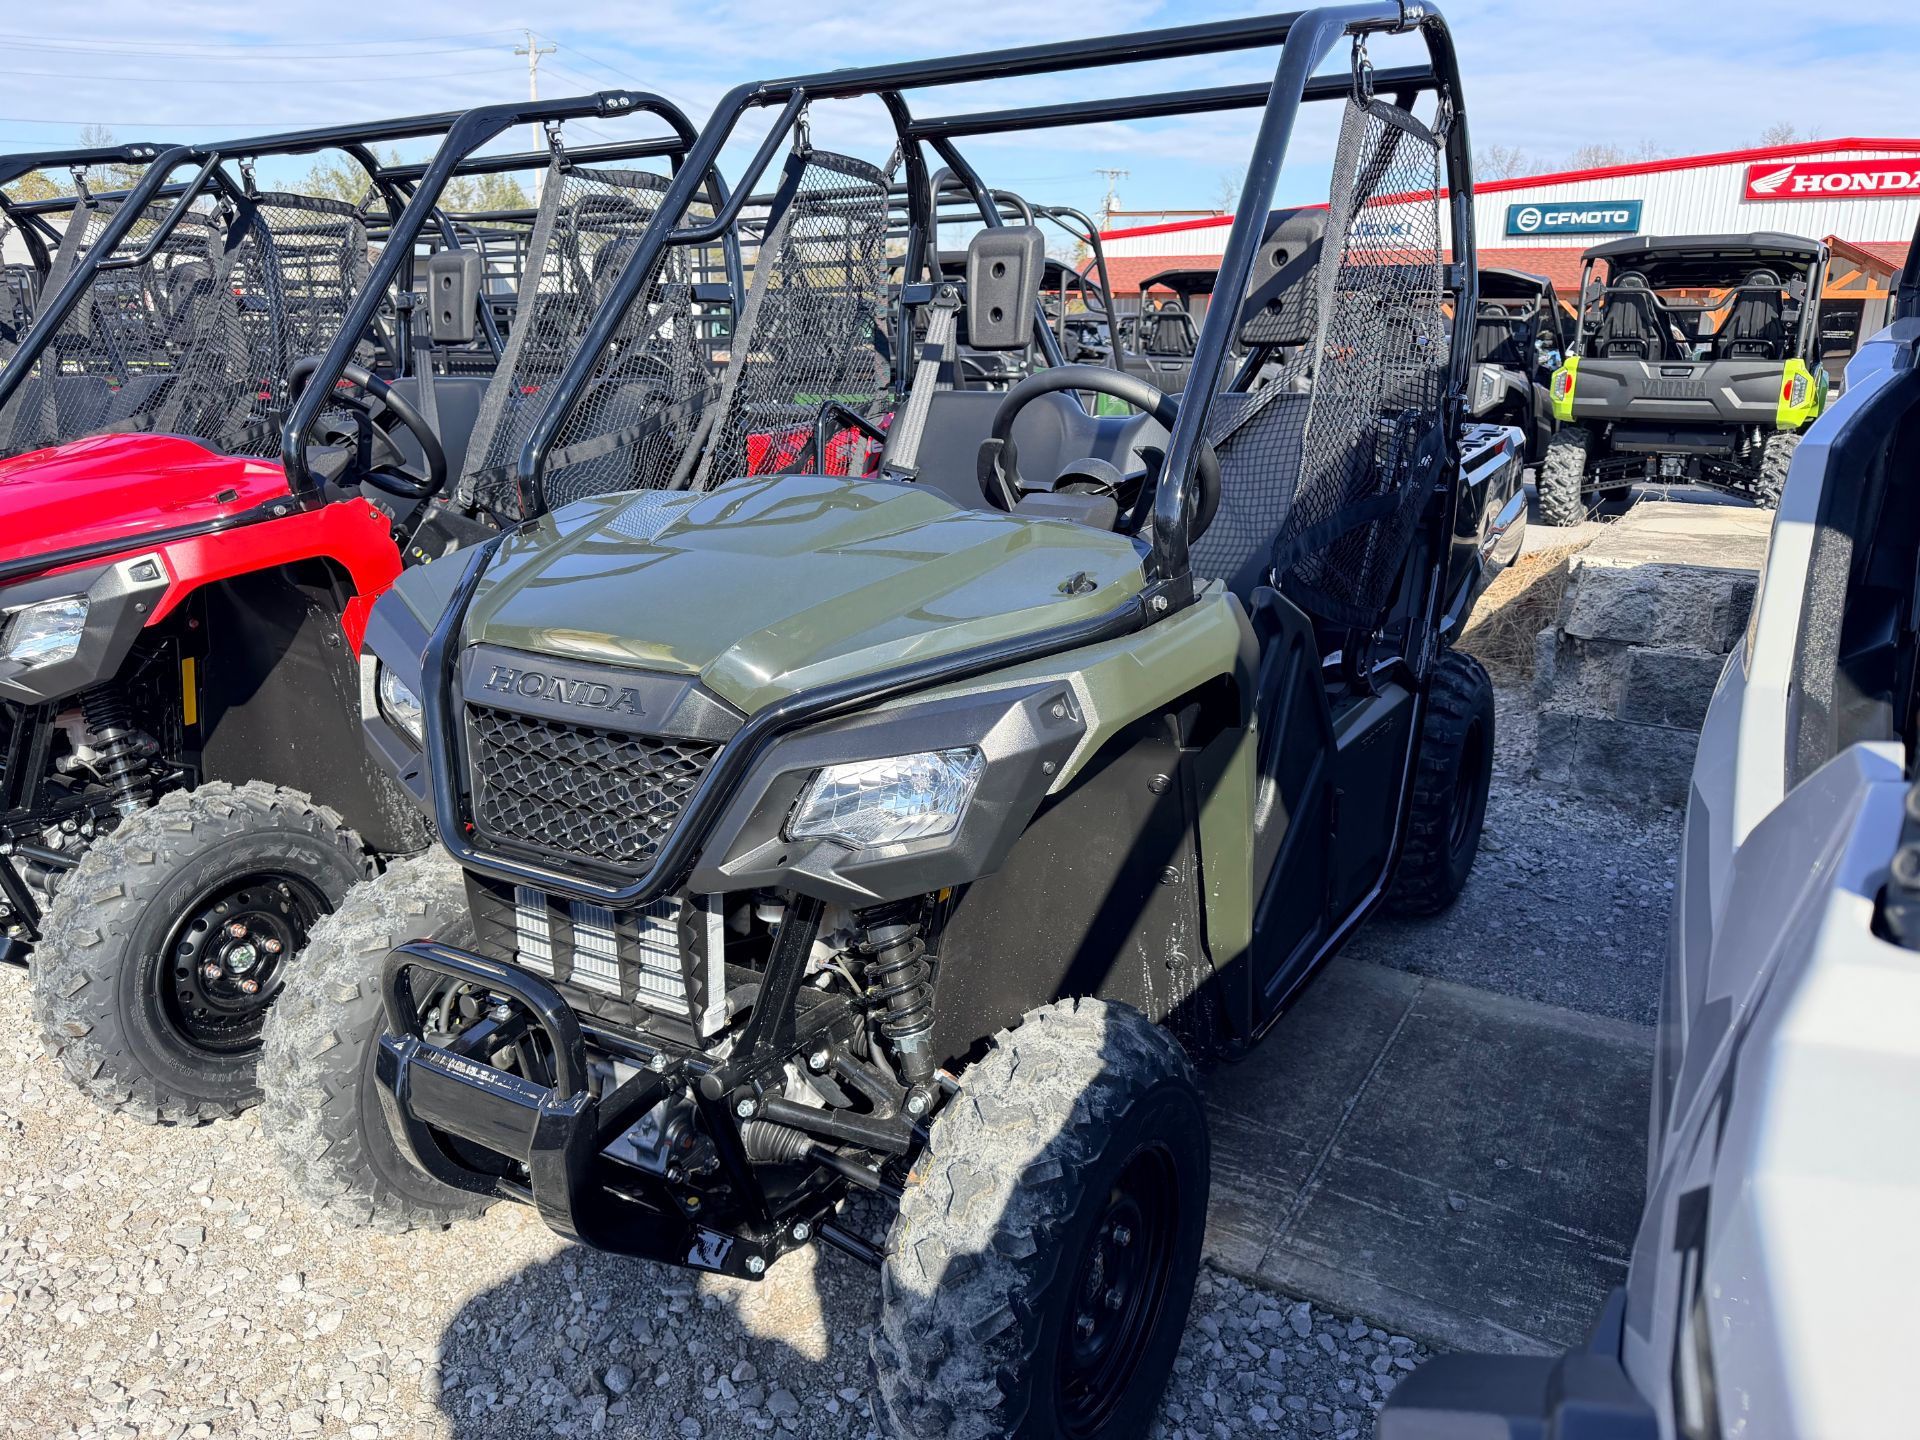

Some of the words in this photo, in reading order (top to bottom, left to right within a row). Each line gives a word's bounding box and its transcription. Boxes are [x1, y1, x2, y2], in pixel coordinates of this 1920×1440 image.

[1544, 210, 1629, 225] CFMOTO
[1641, 380, 1706, 397] YAMAHA
[483, 665, 646, 717] HONDA
